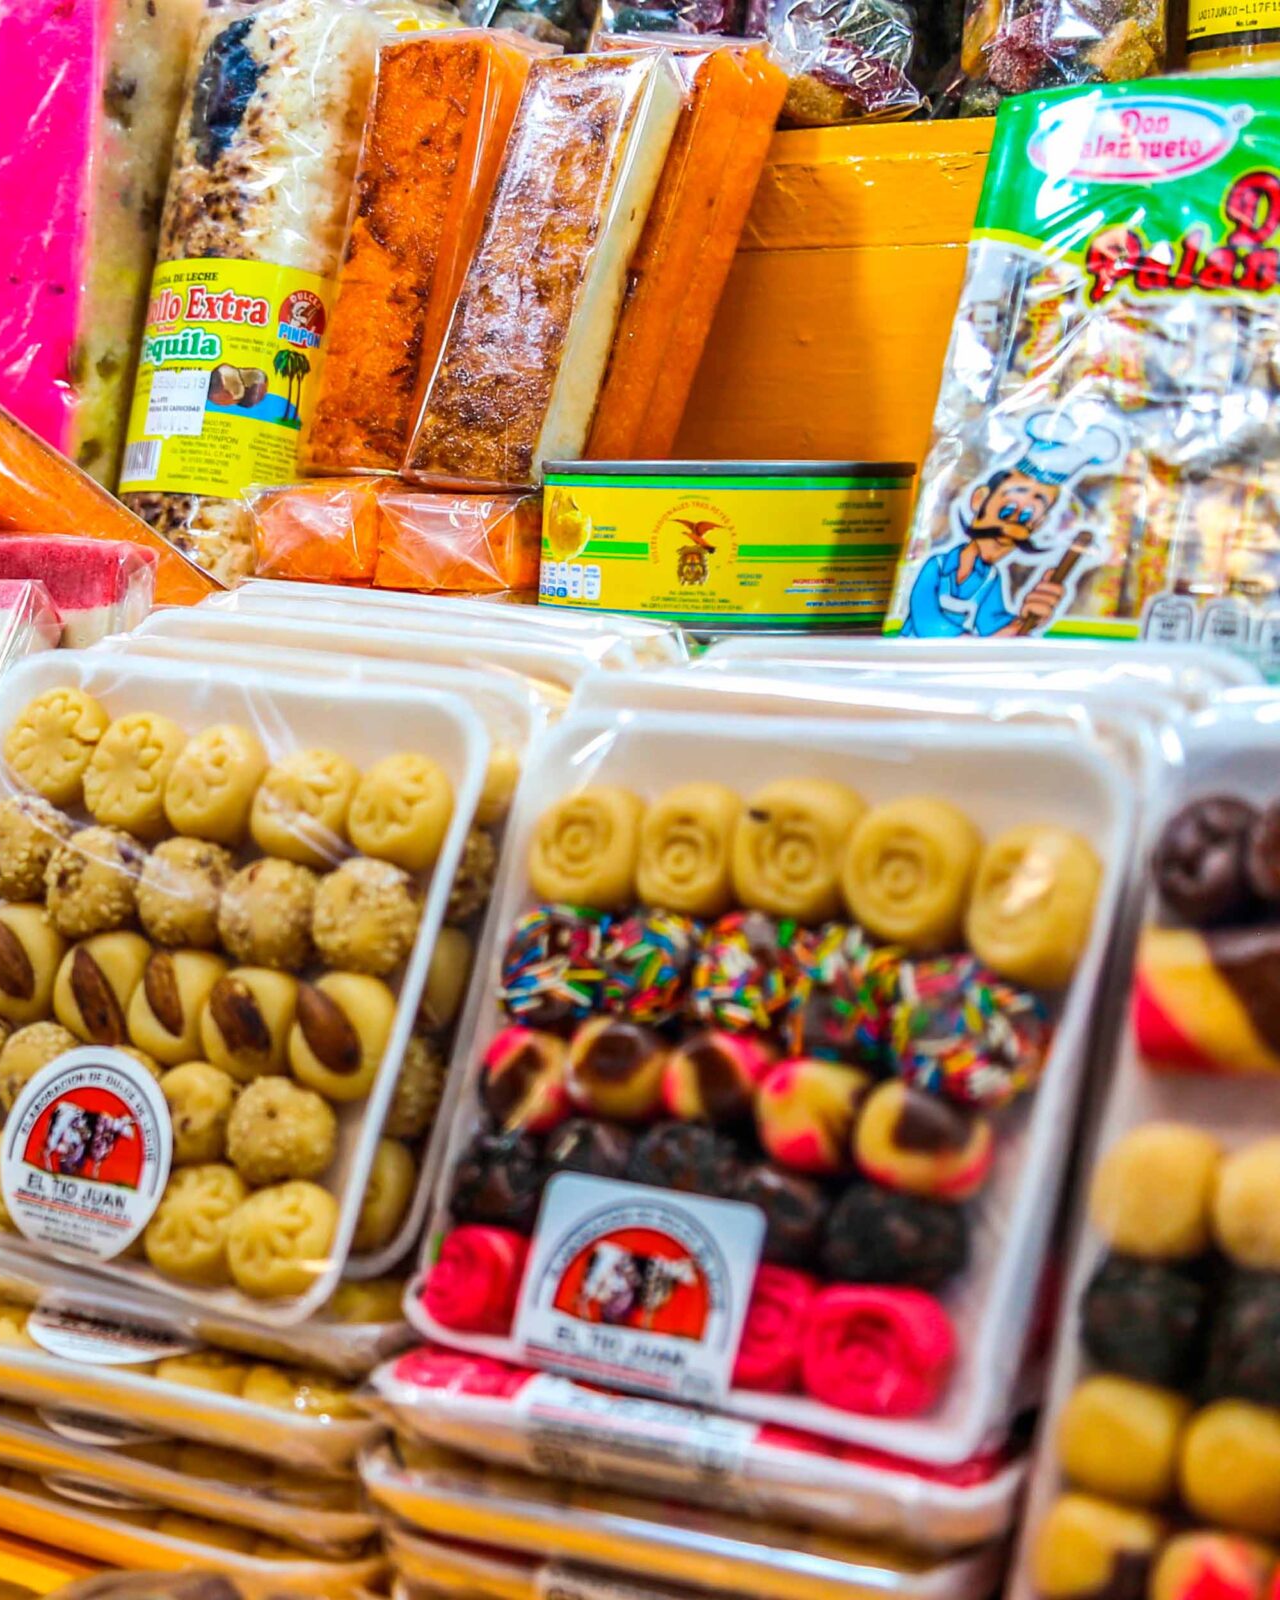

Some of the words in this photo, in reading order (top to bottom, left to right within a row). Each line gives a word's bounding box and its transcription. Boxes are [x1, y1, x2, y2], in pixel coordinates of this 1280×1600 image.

[1121, 109, 1170, 135] Don
[186, 272, 218, 282] LECHE
[147, 290, 182, 324] ollo
[186, 287, 269, 325] Extra
[144, 332, 218, 362] equila
[27, 1173, 45, 1189] EL
[53, 1179, 78, 1199] TIO
[82, 1187, 128, 1210] JUAN
